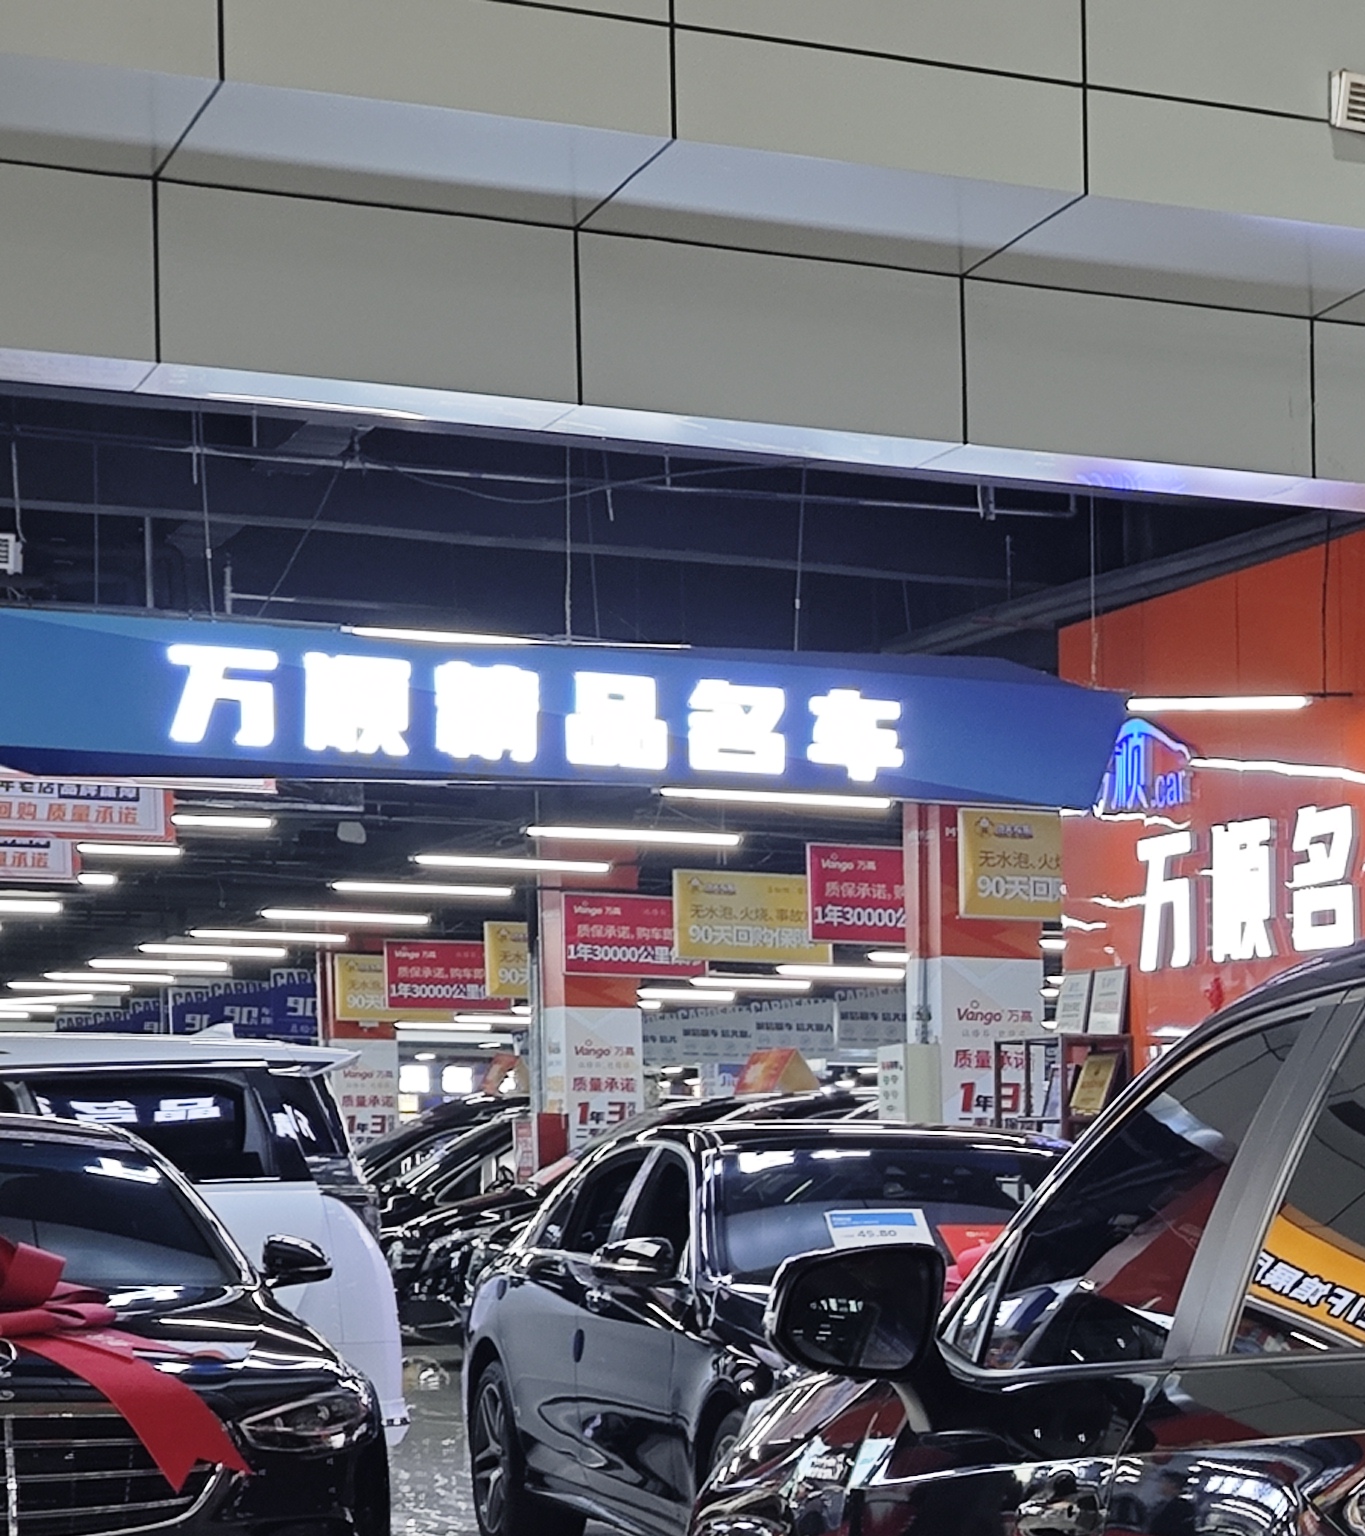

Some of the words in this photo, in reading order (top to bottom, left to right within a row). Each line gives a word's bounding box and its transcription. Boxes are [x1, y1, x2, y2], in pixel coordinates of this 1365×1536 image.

[47, 802, 139, 825] 质量承诺
[956, 1000, 1003, 1026] Vango
[1007, 1009, 1033, 1023] 万高
